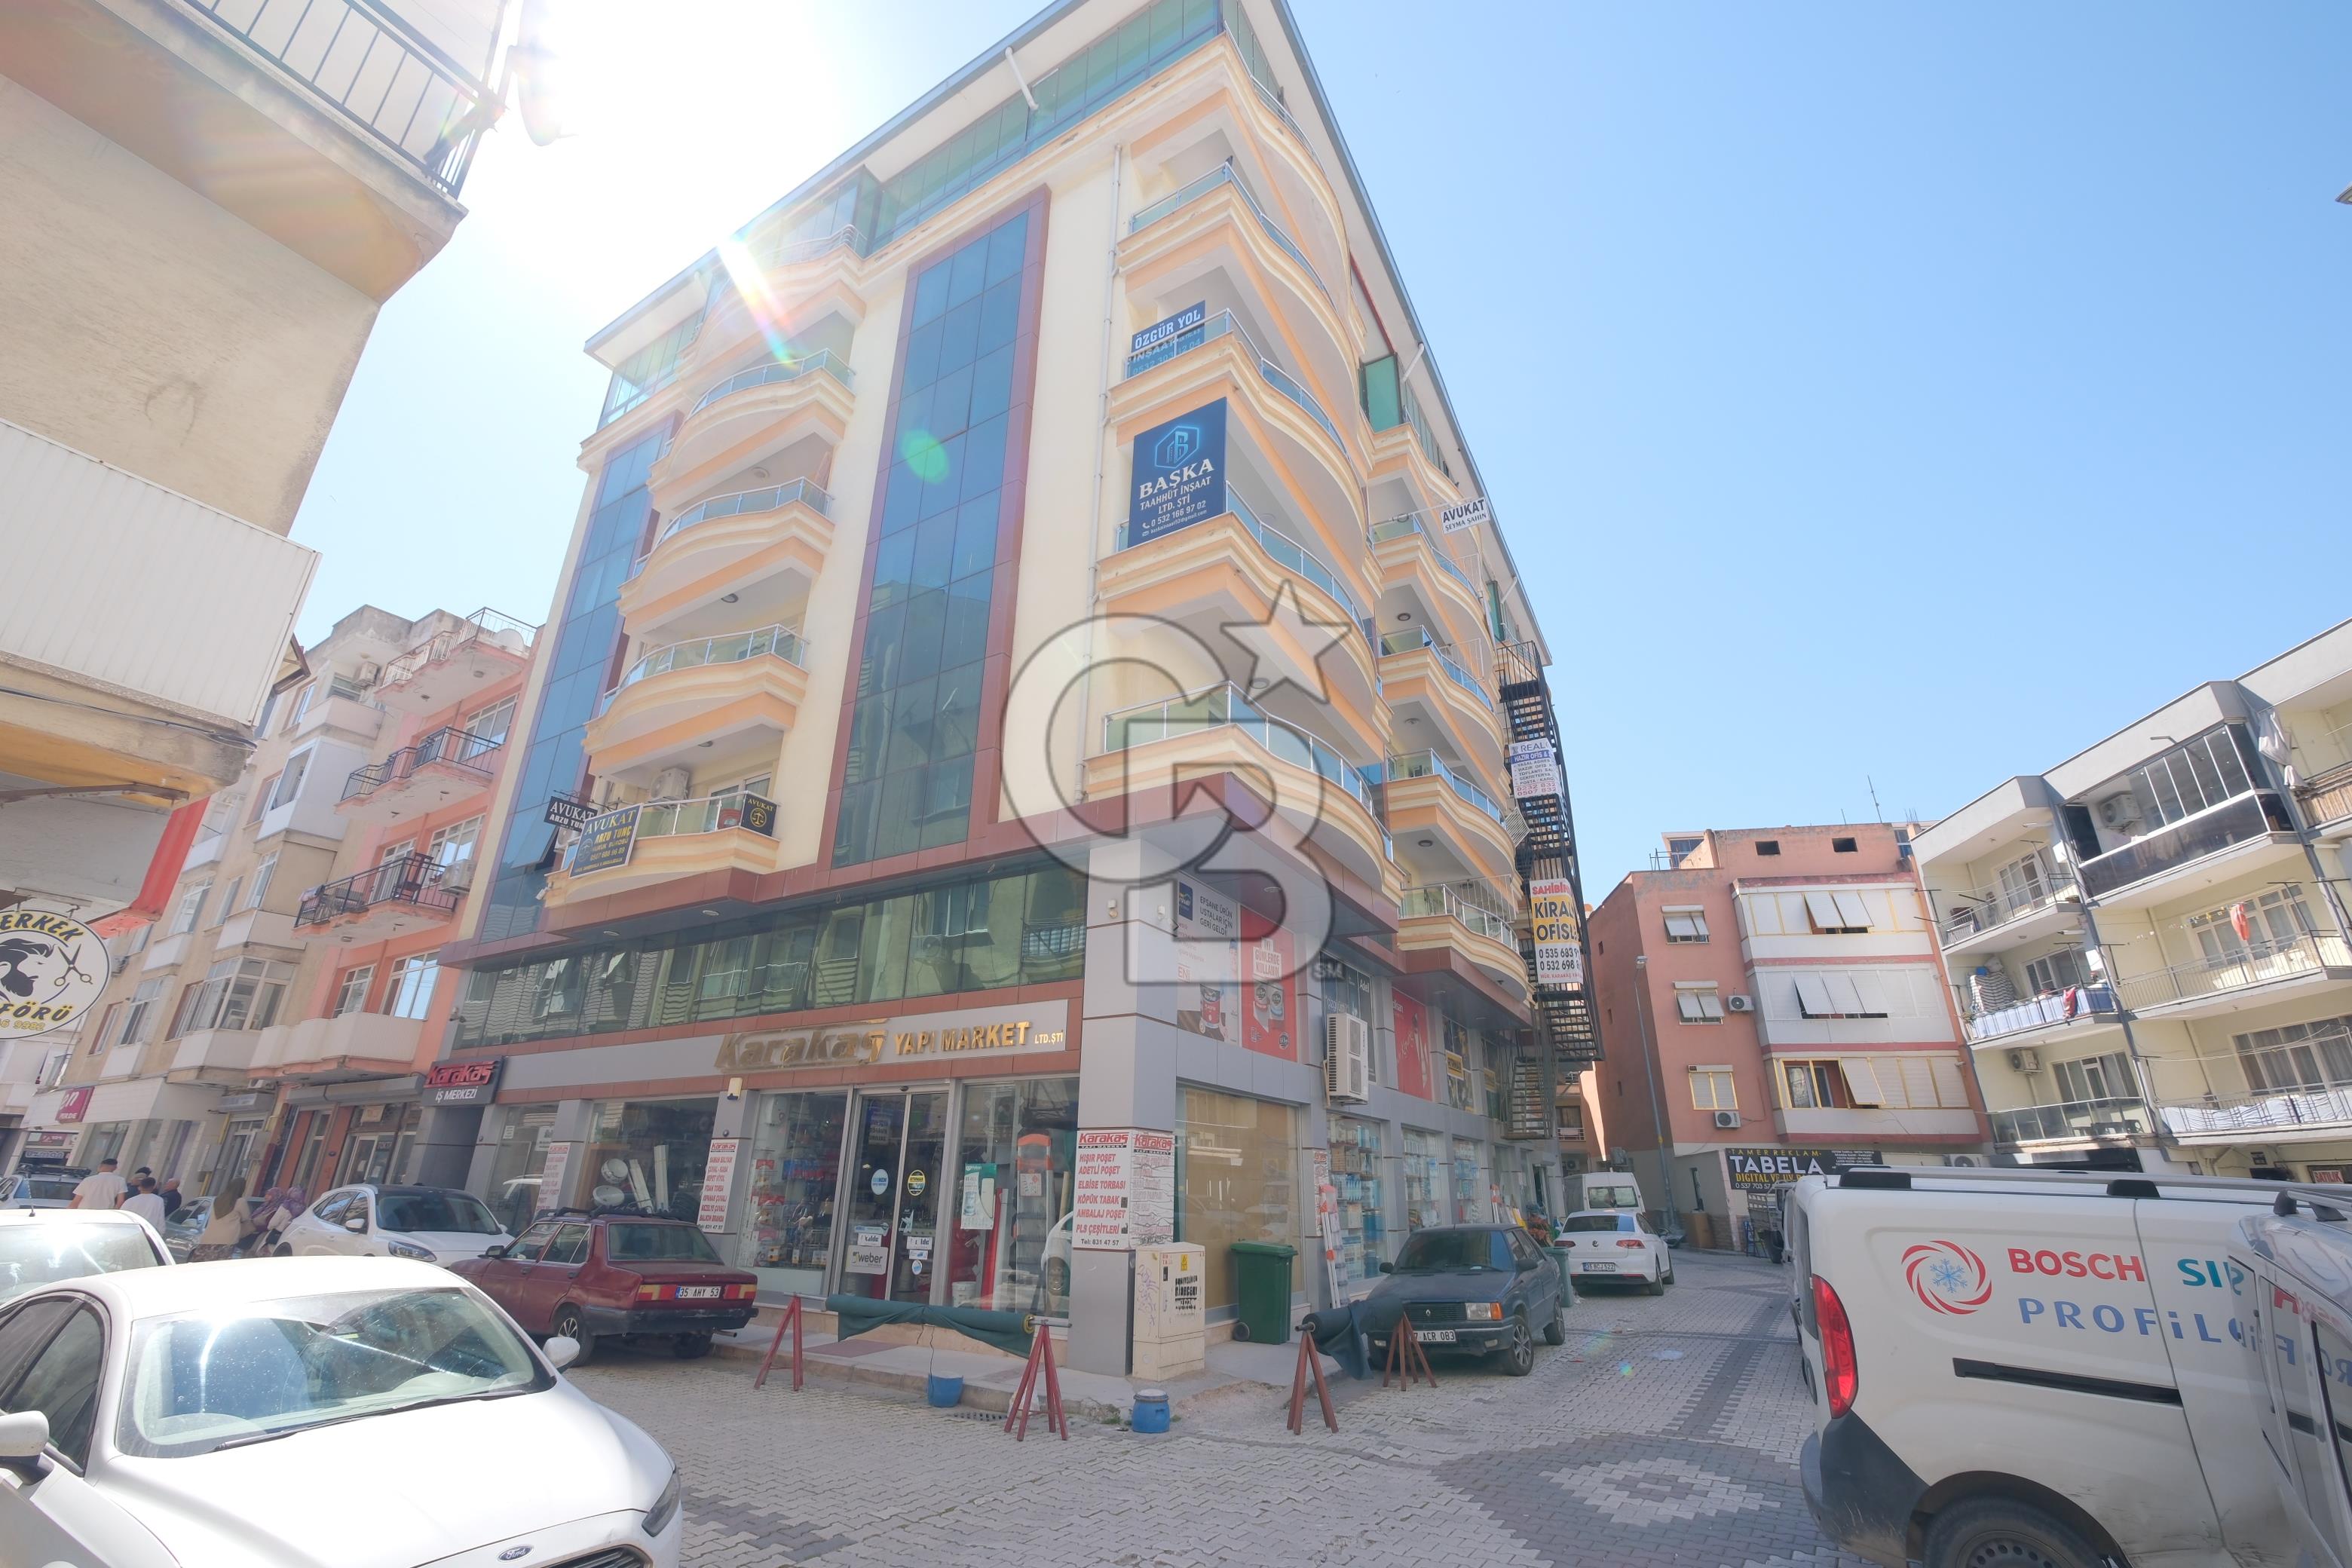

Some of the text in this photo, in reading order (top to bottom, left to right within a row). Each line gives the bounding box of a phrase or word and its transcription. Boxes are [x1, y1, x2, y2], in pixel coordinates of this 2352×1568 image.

[1135, 322, 1174, 349] ÖZGÜR
[1178, 310, 1201, 329] YOL
[1139, 458, 1215, 499] BAŞKA
[1140, 476, 1211, 510] TAAHHÜT İNŞAAT
[1157, 514, 1170, 525] 532
[1171, 508, 1184, 519] 166
[1186, 504, 1195, 513] 97
[1197, 501, 1206, 510] 02
[1158, 502, 1175, 514] LTD.
[1443, 499, 1484, 523] AVUKAT
[1521, 743, 1546, 752] REAL
[550, 801, 595, 821] AVUKAT
[747, 798, 773, 812] AVUKAT
[550, 814, 584, 829] ARZU TUN
[584, 810, 636, 836] AVUKAT
[594, 831, 612, 845] ARZU
[1200, 896, 1219, 912] EFSANE
[1219, 902, 1233, 919] ÜRÜN
[1200, 907, 1222, 924] USTALAR
[0, 913, 84, 942] ERKEK
[1200, 917, 1211, 929] GERİ
[1539, 948, 1573, 959] 0 535 683
[1540, 961, 1545, 971] 0
[1546, 961, 1560, 971] 532
[1561, 960, 1575, 970] 698
[0, 1001, 73, 1021] FÖRÜ
[13, 1021, 45, 1031] 9982
[714, 1029, 889, 1069] Karakaş
[894, 1031, 936, 1056] YAPI
[941, 1021, 1032, 1052] MARKET
[424, 1063, 495, 1087] Karakaş
[443, 1086, 479, 1101] MERKEZİ
[1079, 1132, 1129, 1144] Karakaş
[1133, 1134, 1172, 1150] Karakaş
[1096, 1153, 1116, 1164] POŞET
[1729, 1156, 1824, 1175] TABELA
[1078, 1164, 1121, 1176] ADETLİ POŞET
[1078, 1179, 1125, 1190] ELBİSE TORBASI
[1077, 1194, 1120, 1205] KÖPÜK TABAK
[1076, 1208, 1126, 1220] AMBALAJ POŞET
[1088, 1222, 1120, 1236] ÇEŞİTLERİ
[858, 1252, 883, 1263] weber
[2007, 1248, 2145, 1282] BOSCH
[679, 1288, 718, 1297] 35 AHY 53
[1423, 1331, 1436, 1341] ACR
[505, 1547, 526, 1560] Ford
